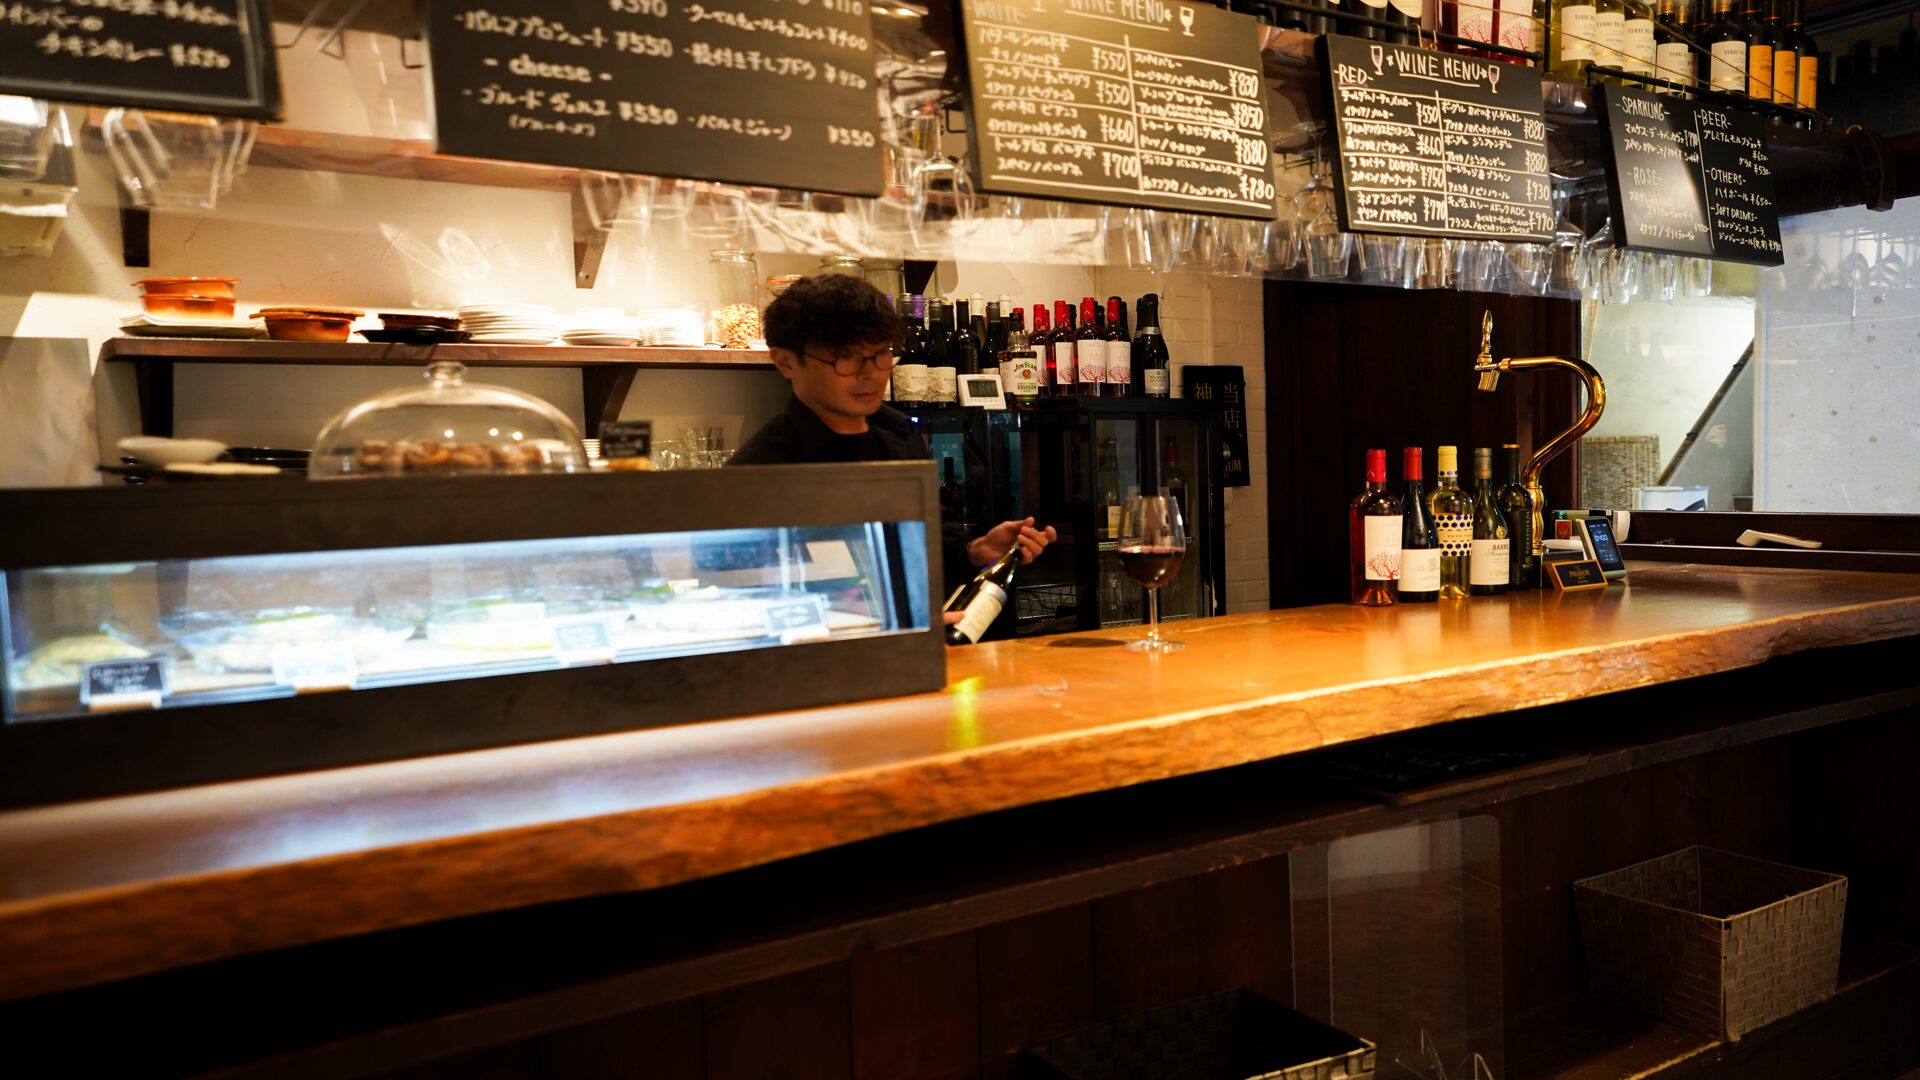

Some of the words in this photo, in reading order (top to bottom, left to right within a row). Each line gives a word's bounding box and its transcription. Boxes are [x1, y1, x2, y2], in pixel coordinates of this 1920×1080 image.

[1091, 45, 1128, 73] ¥550
[1394, 48, 1441, 77] WINE
[1443, 57, 1481, 81] MENU
[1096, 79, 1132, 107] ¥550
[617, 101, 680, 126] ¥550
[1415, 101, 1440, 127] ¥550
[826, 125, 876, 148] ¥550
[1098, 113, 1136, 144] ¥660
[1523, 117, 1546, 141] ¥880
[1416, 133, 1443, 157] ¥660
[1524, 149, 1548, 174] ¥880
[1420, 164, 1445, 189] ¥750
[1525, 178, 1552, 203] ¥930
[1528, 209, 1555, 232] ¥990
